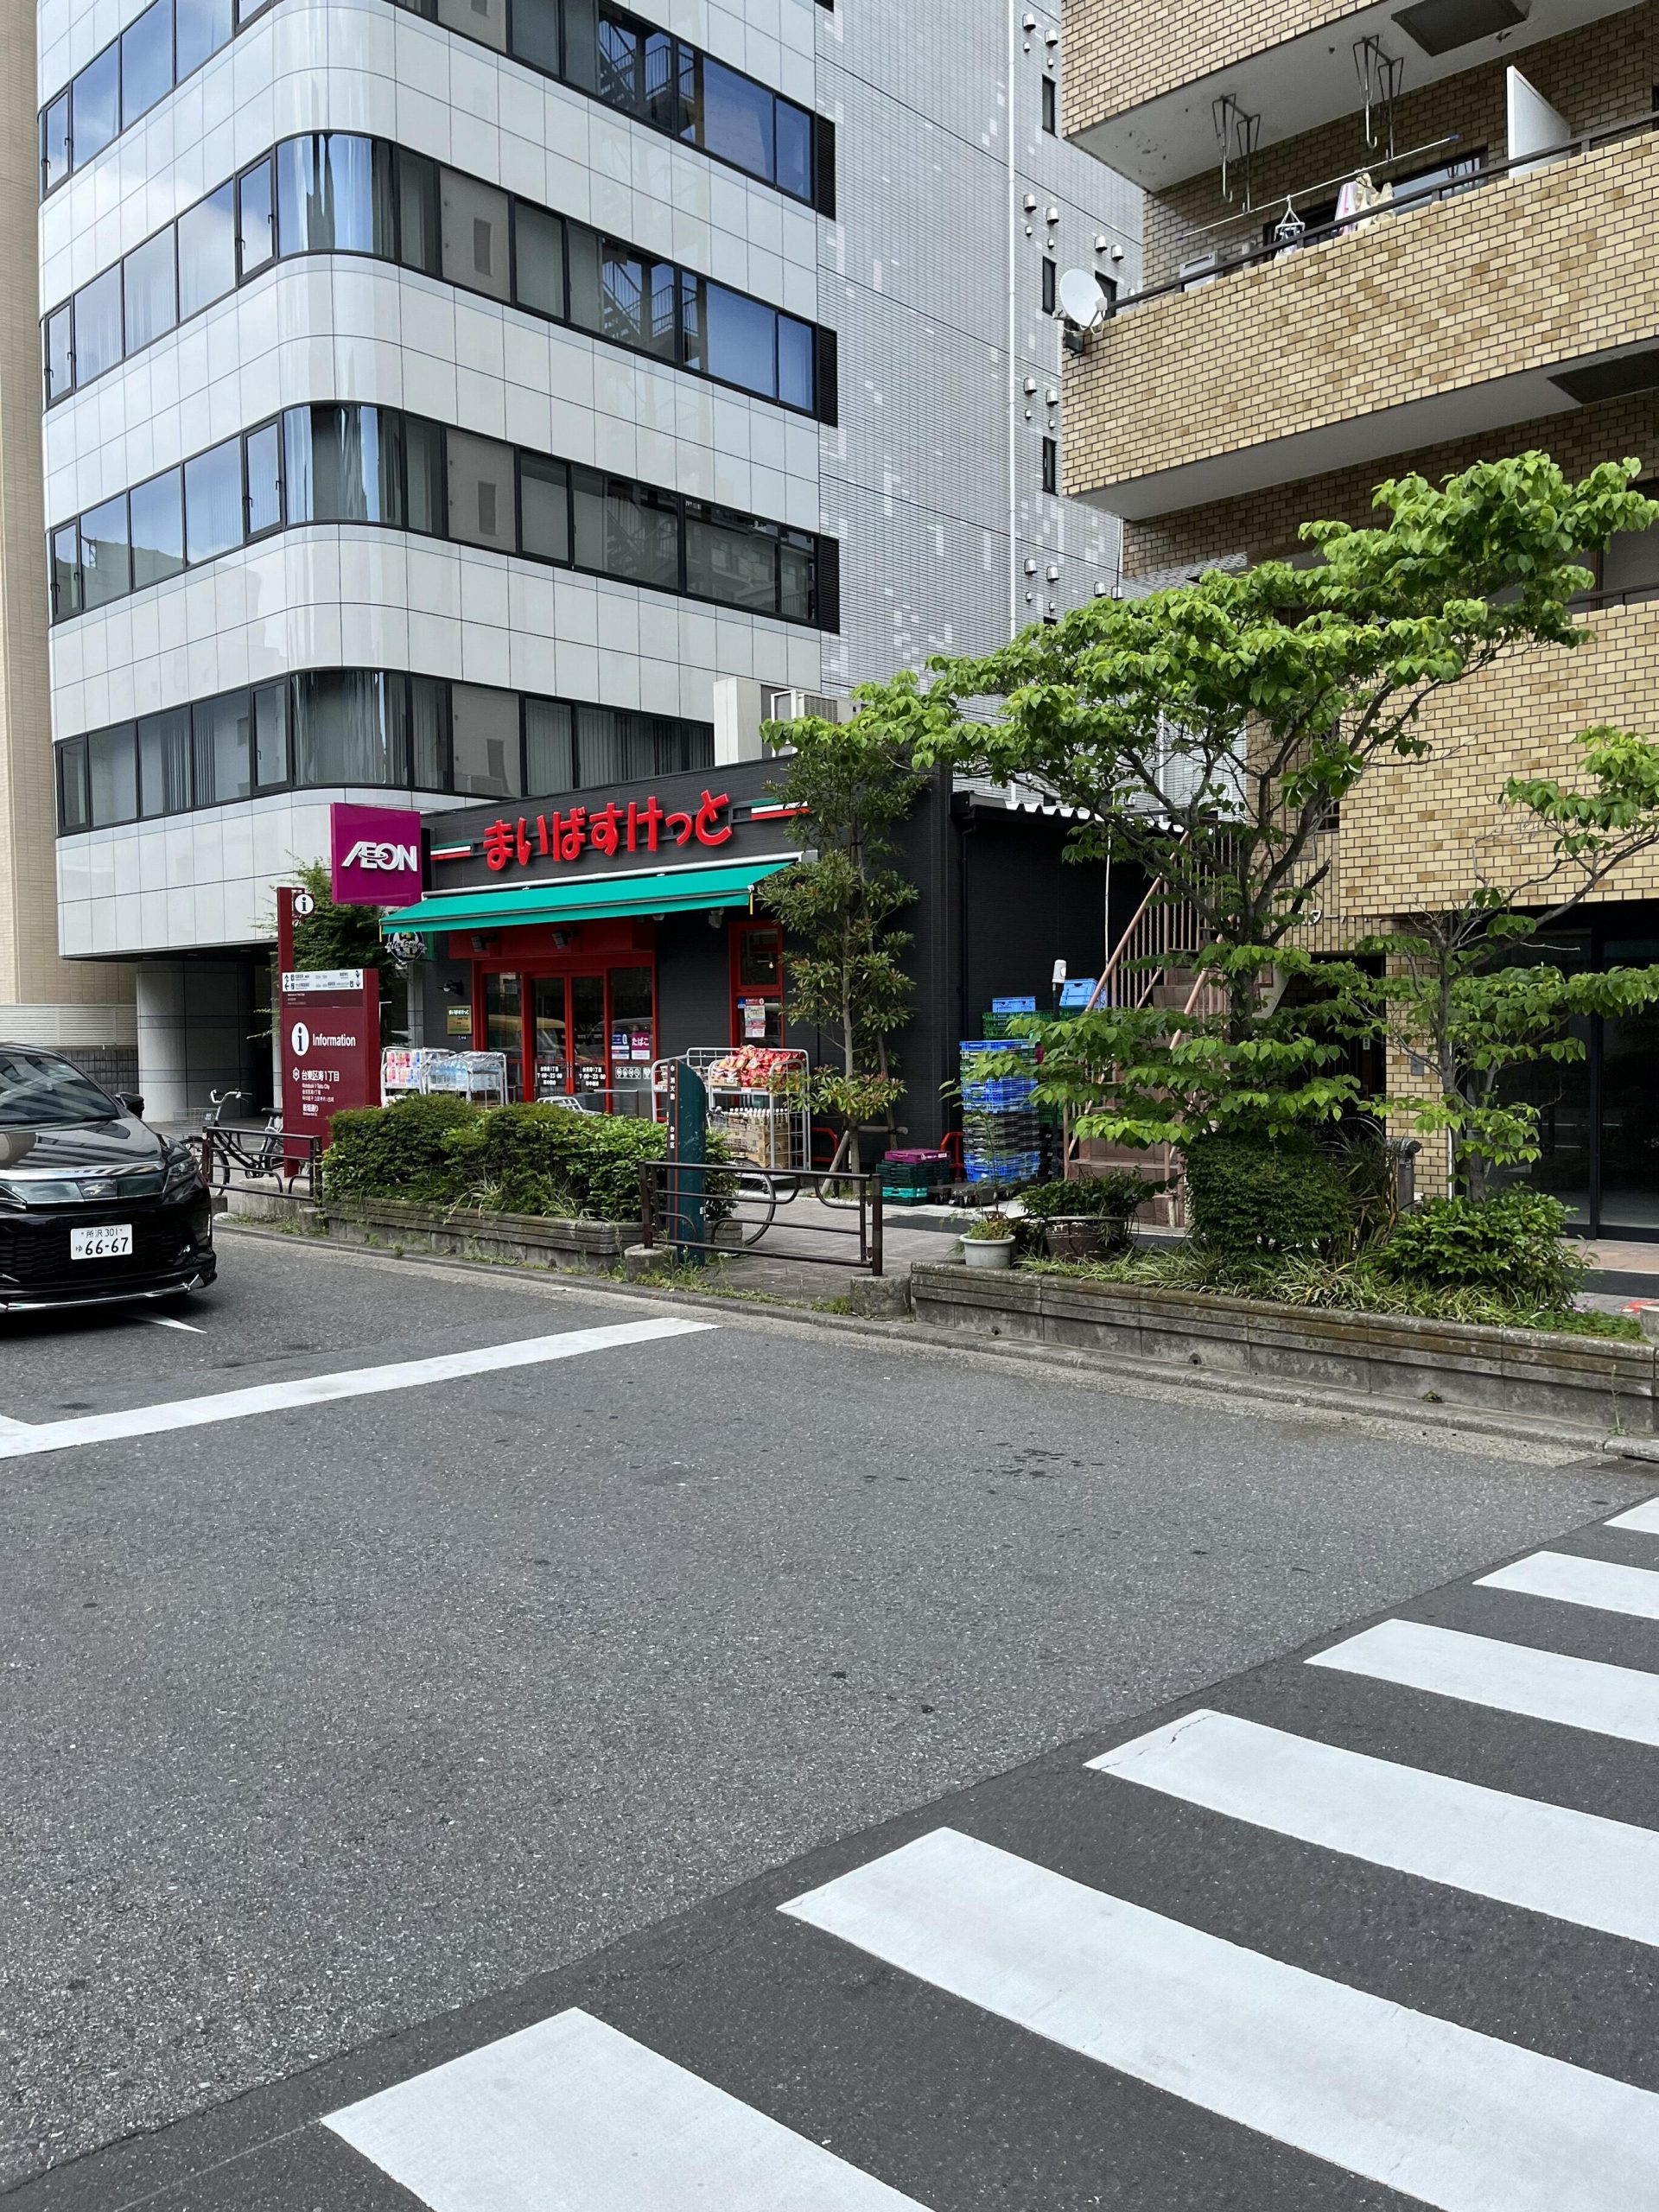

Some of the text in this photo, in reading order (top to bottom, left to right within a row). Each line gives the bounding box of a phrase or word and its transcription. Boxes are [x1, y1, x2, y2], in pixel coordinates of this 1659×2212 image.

[483, 789, 733, 872] まいばすけっと
[313, 1033, 356, 1046] Information
[632, 1037, 649, 1046] たばこ
[86, 1228, 118, 1238] 所沢 301
[85, 1237, 129, 1255] 66-67
